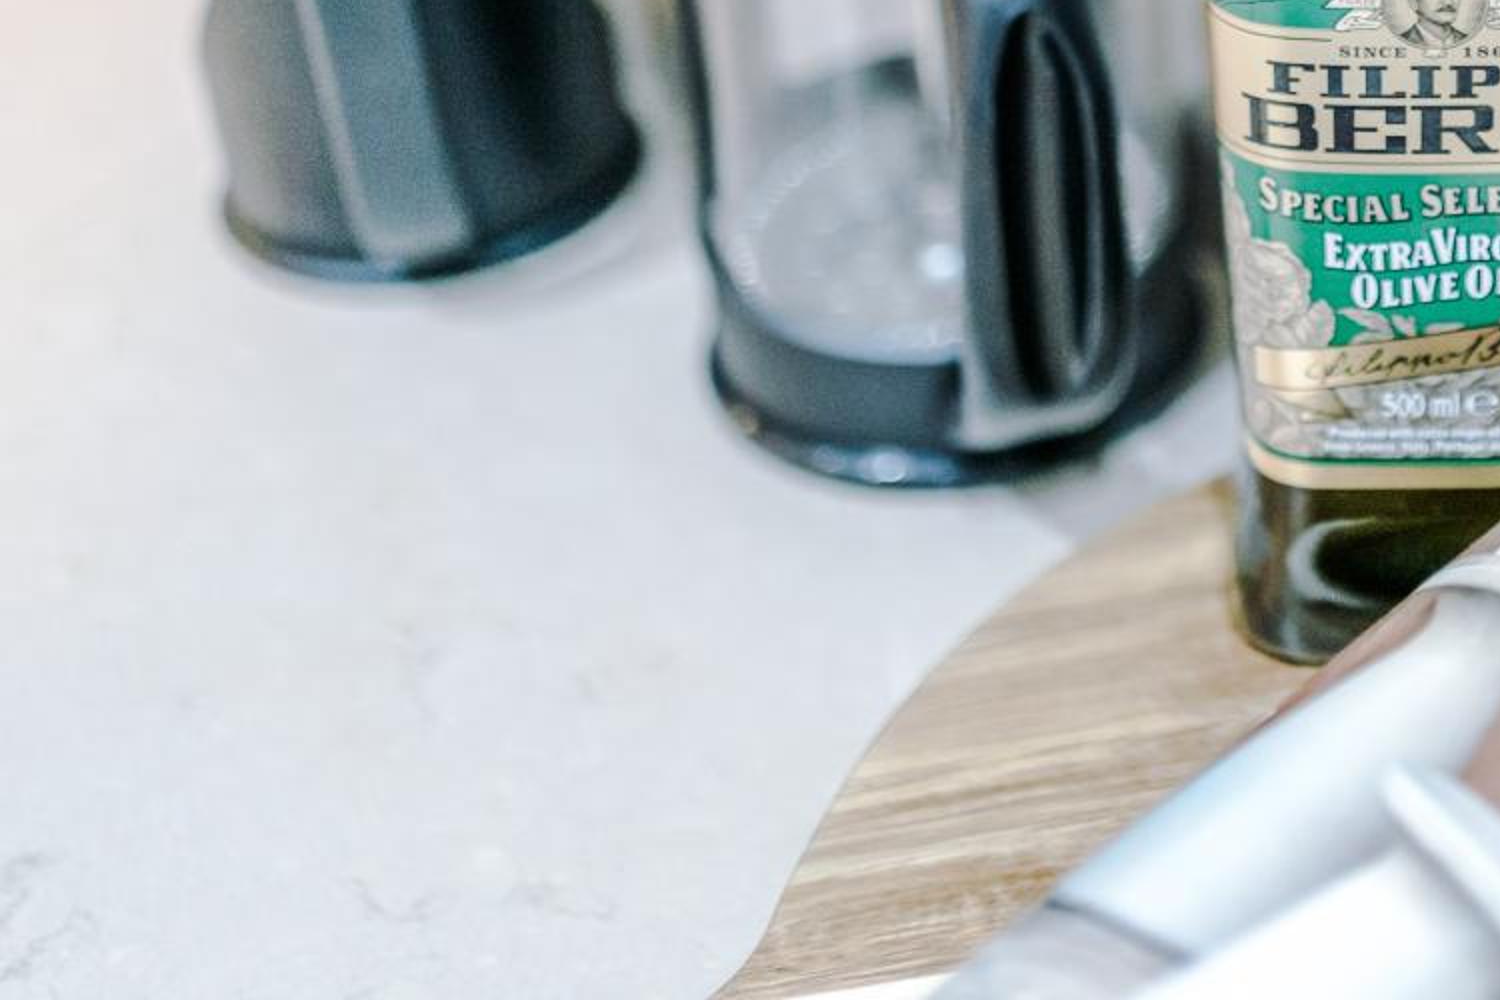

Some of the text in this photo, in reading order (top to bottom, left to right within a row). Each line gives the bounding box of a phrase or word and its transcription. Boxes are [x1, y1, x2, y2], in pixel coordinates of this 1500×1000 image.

[1339, 45, 1408, 59] SINCE
[1259, 176, 1411, 224] SPECIAL
[1351, 271, 1460, 310] OLIVE
[1381, 391, 1427, 419] 500
[1428, 390, 1461, 418] ml
